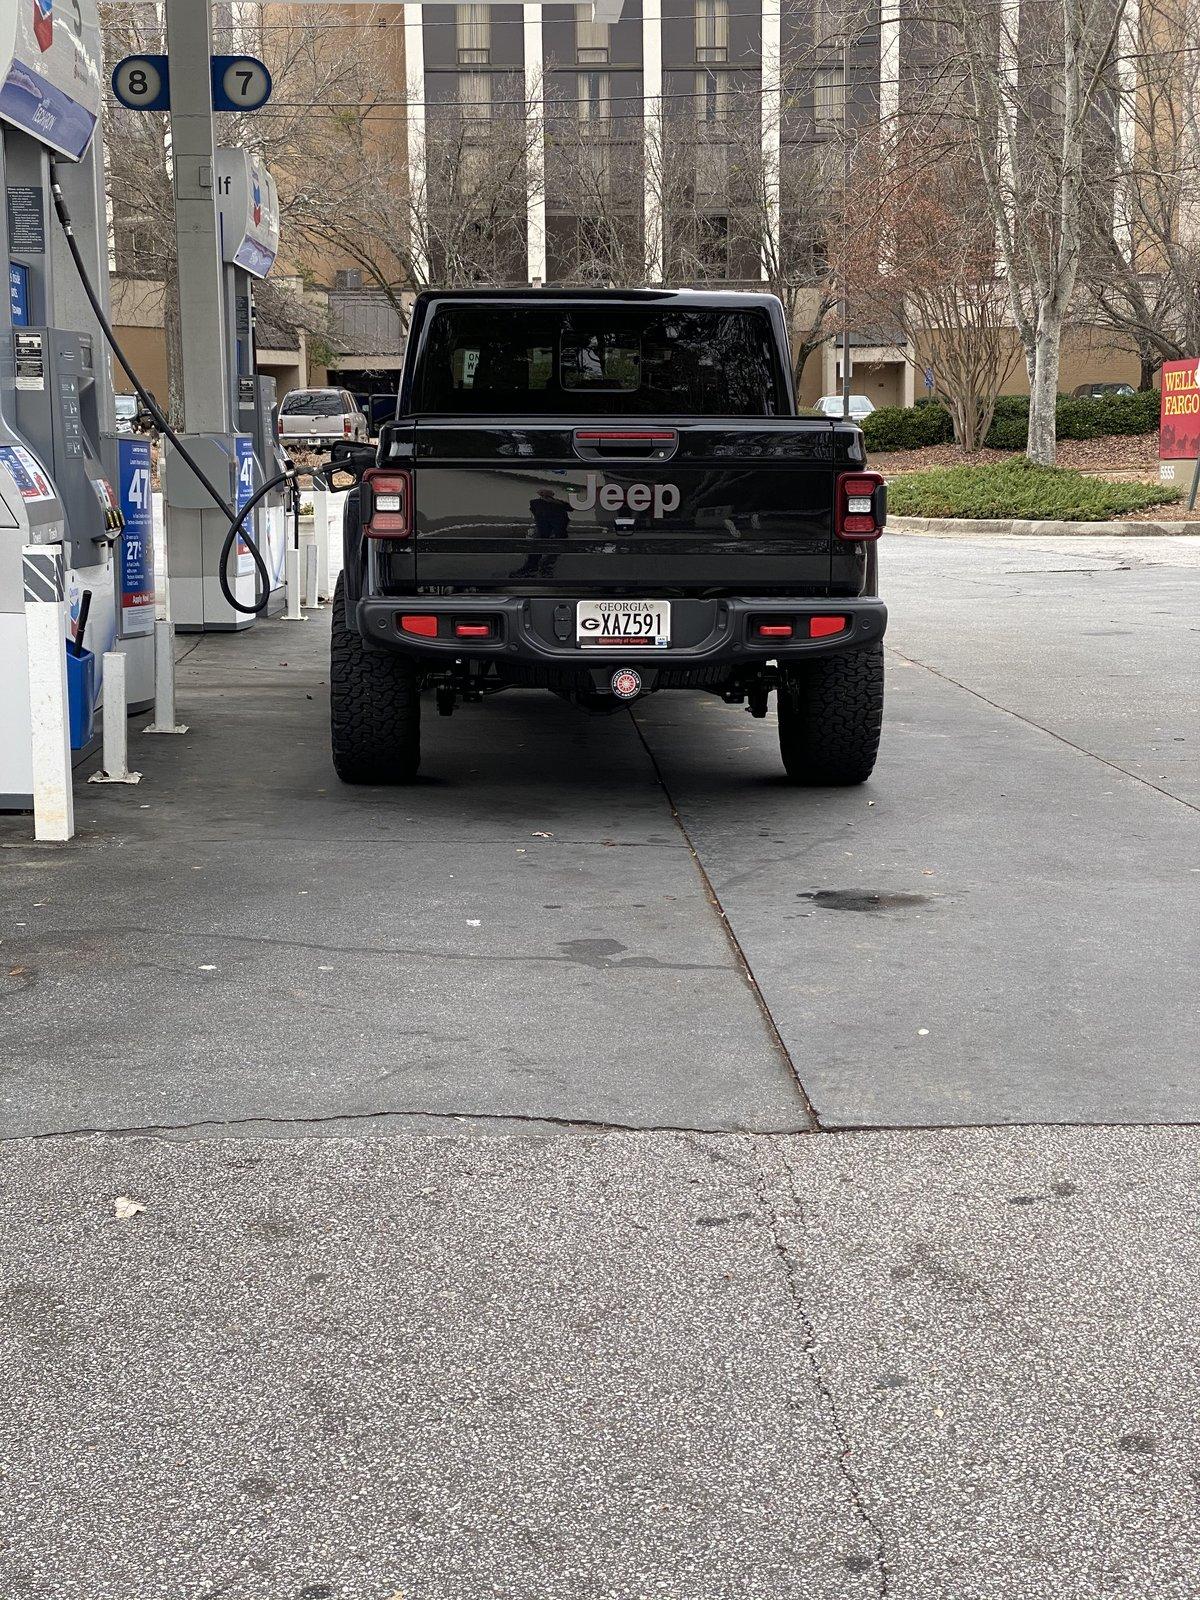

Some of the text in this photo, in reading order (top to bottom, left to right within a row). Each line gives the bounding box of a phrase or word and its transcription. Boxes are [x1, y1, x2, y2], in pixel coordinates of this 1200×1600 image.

[128, 70, 148, 95] 8
[235, 71, 253, 96] 7
[1164, 393, 1200, 416] FARGO
[1160, 465, 1175, 480] 5555
[568, 474, 681, 519] Jeep
[598, 602, 650, 612] GEORGIA
[601, 613, 661, 636] XAZ591
